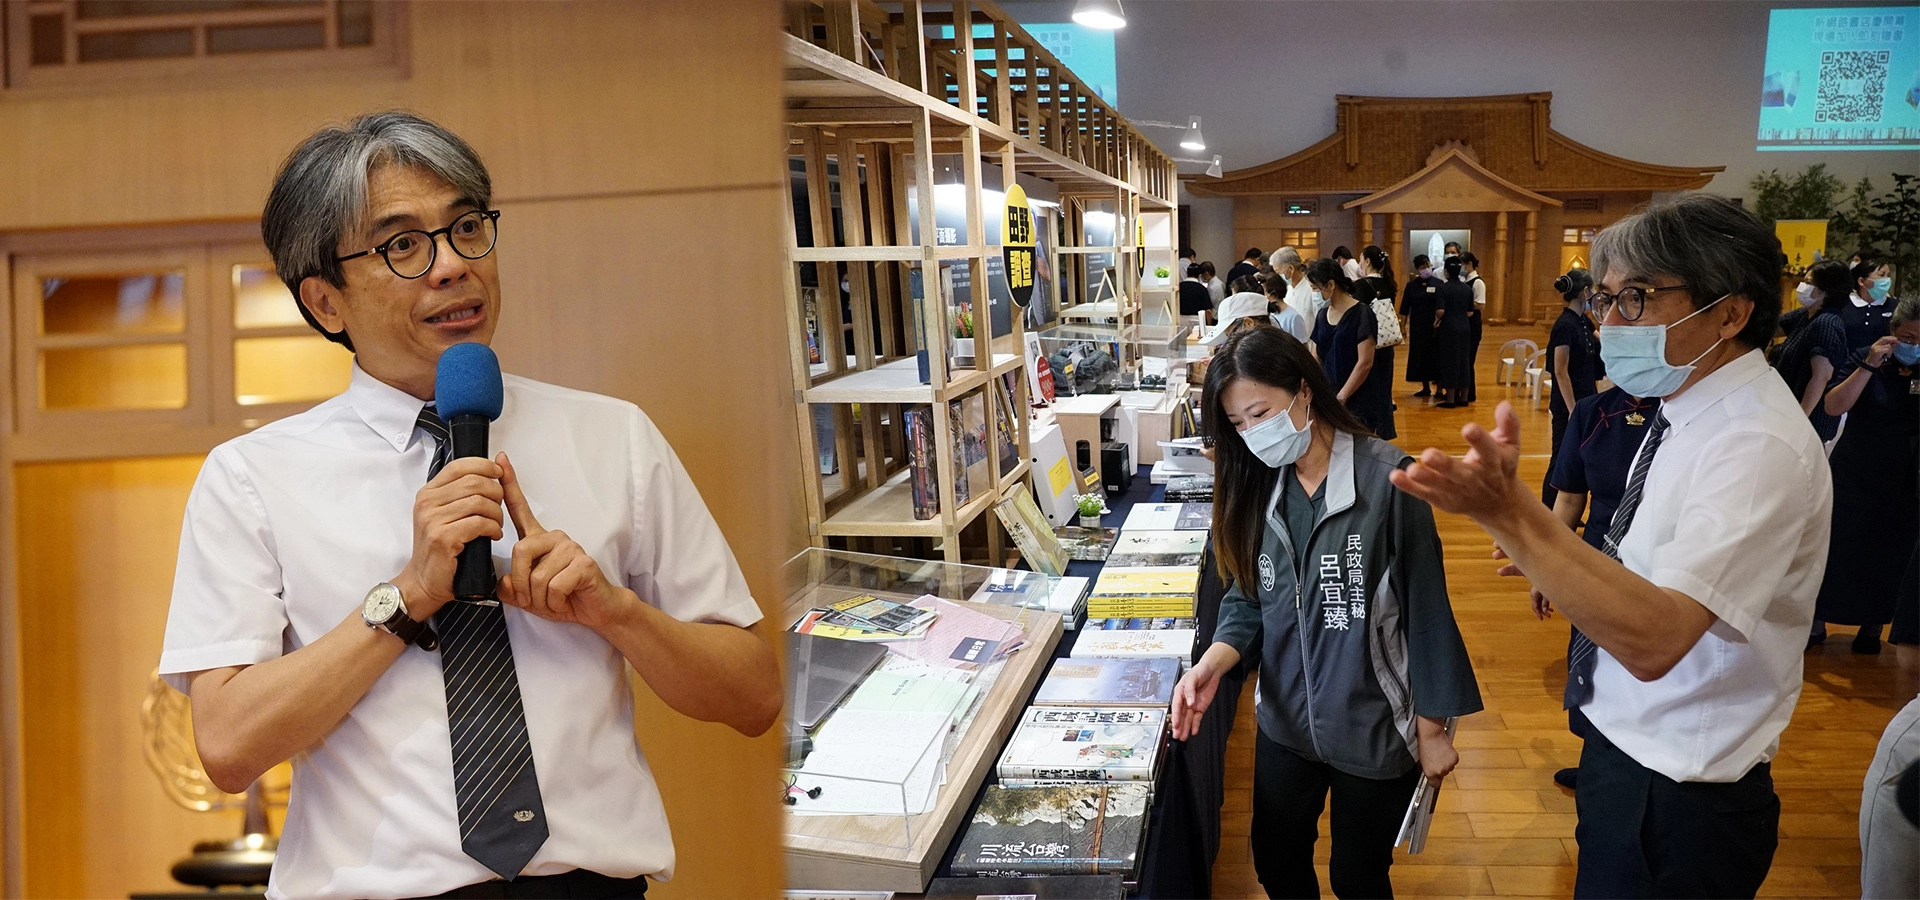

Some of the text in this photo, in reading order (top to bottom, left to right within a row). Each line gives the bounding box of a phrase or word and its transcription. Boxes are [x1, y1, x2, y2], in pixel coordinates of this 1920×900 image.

[1008, 205, 1030, 244] 田野
[1009, 249, 1033, 290] 調查
[1319, 554, 1350, 631] 呂宜臻
[1346, 534, 1366, 620] 民政局主秘
[980, 841, 1070, 857] 川流台灣
